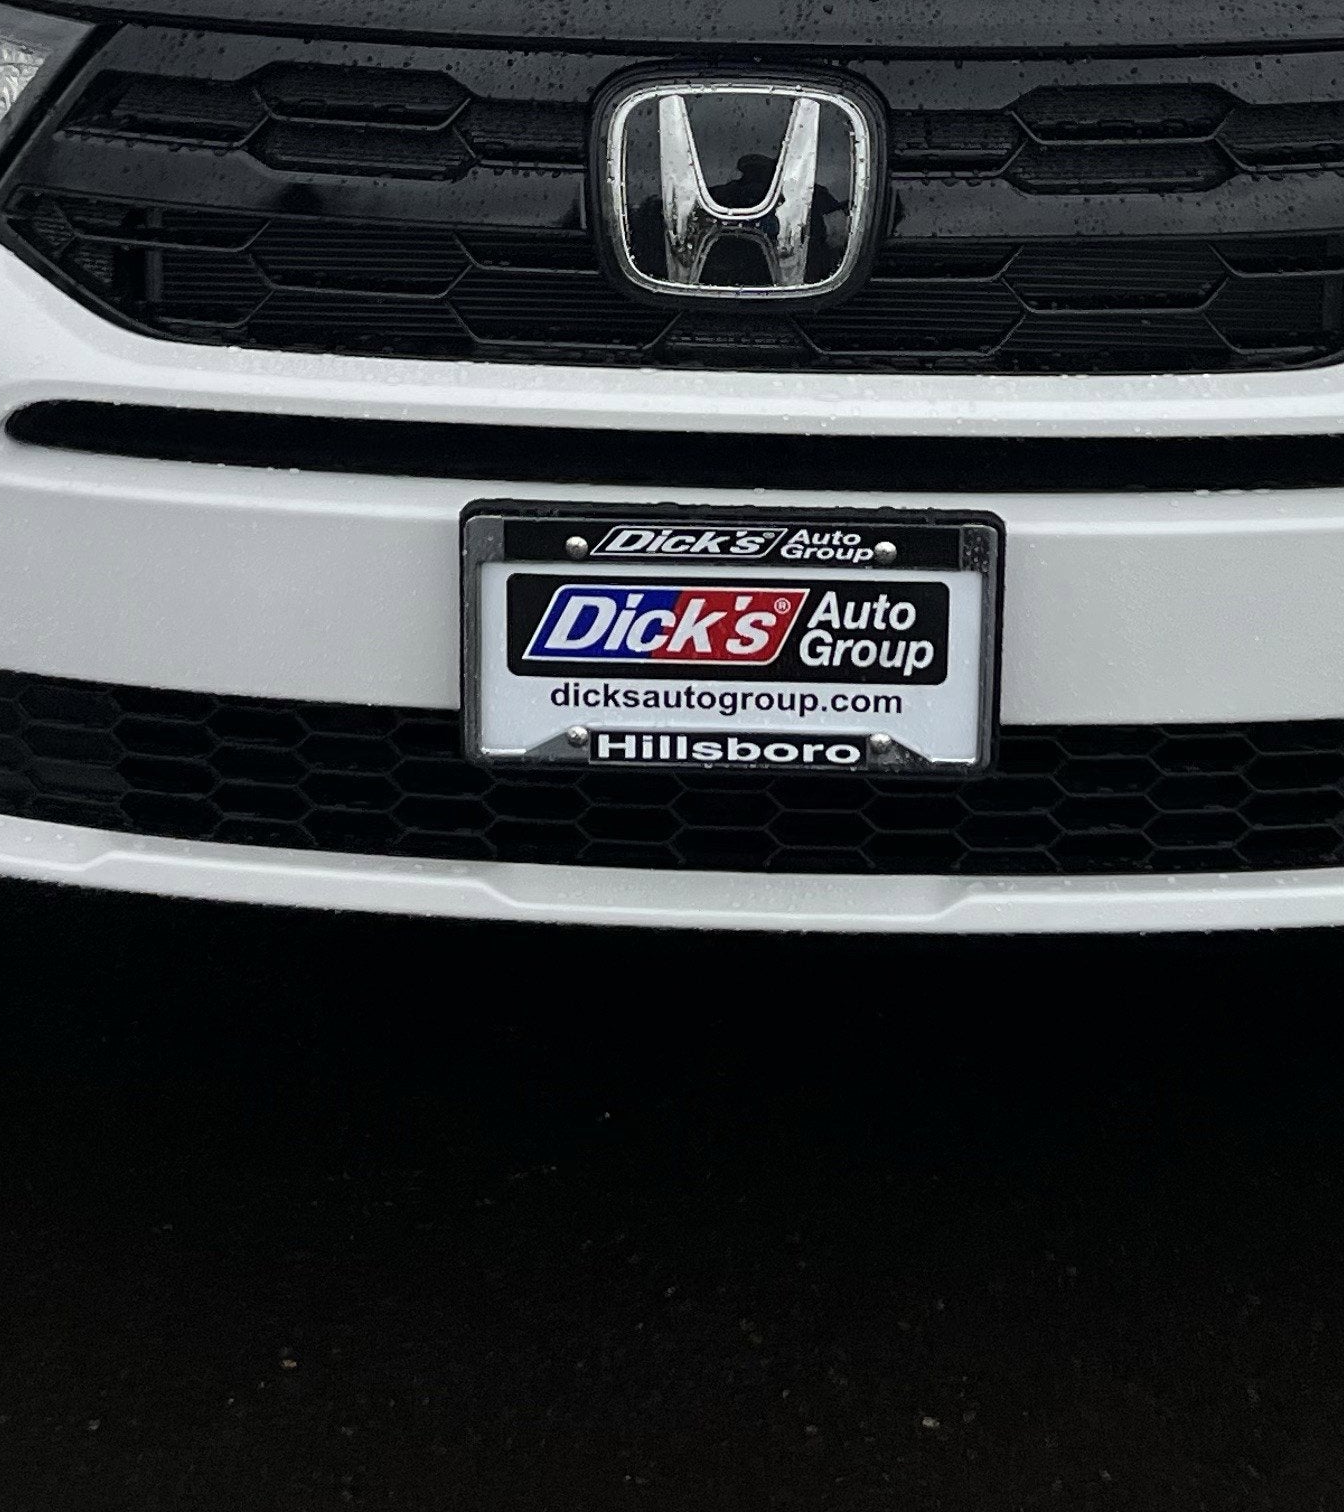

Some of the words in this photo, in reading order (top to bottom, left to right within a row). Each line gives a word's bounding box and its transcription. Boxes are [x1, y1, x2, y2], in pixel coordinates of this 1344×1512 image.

[780, 543, 874, 563] Group
[787, 528, 862, 545] Auto
[806, 590, 917, 631] Auto
[799, 629, 935, 677] Group
[549, 681, 903, 717] dicksautogroup.com
[597, 733, 861, 765] Hillsboro
